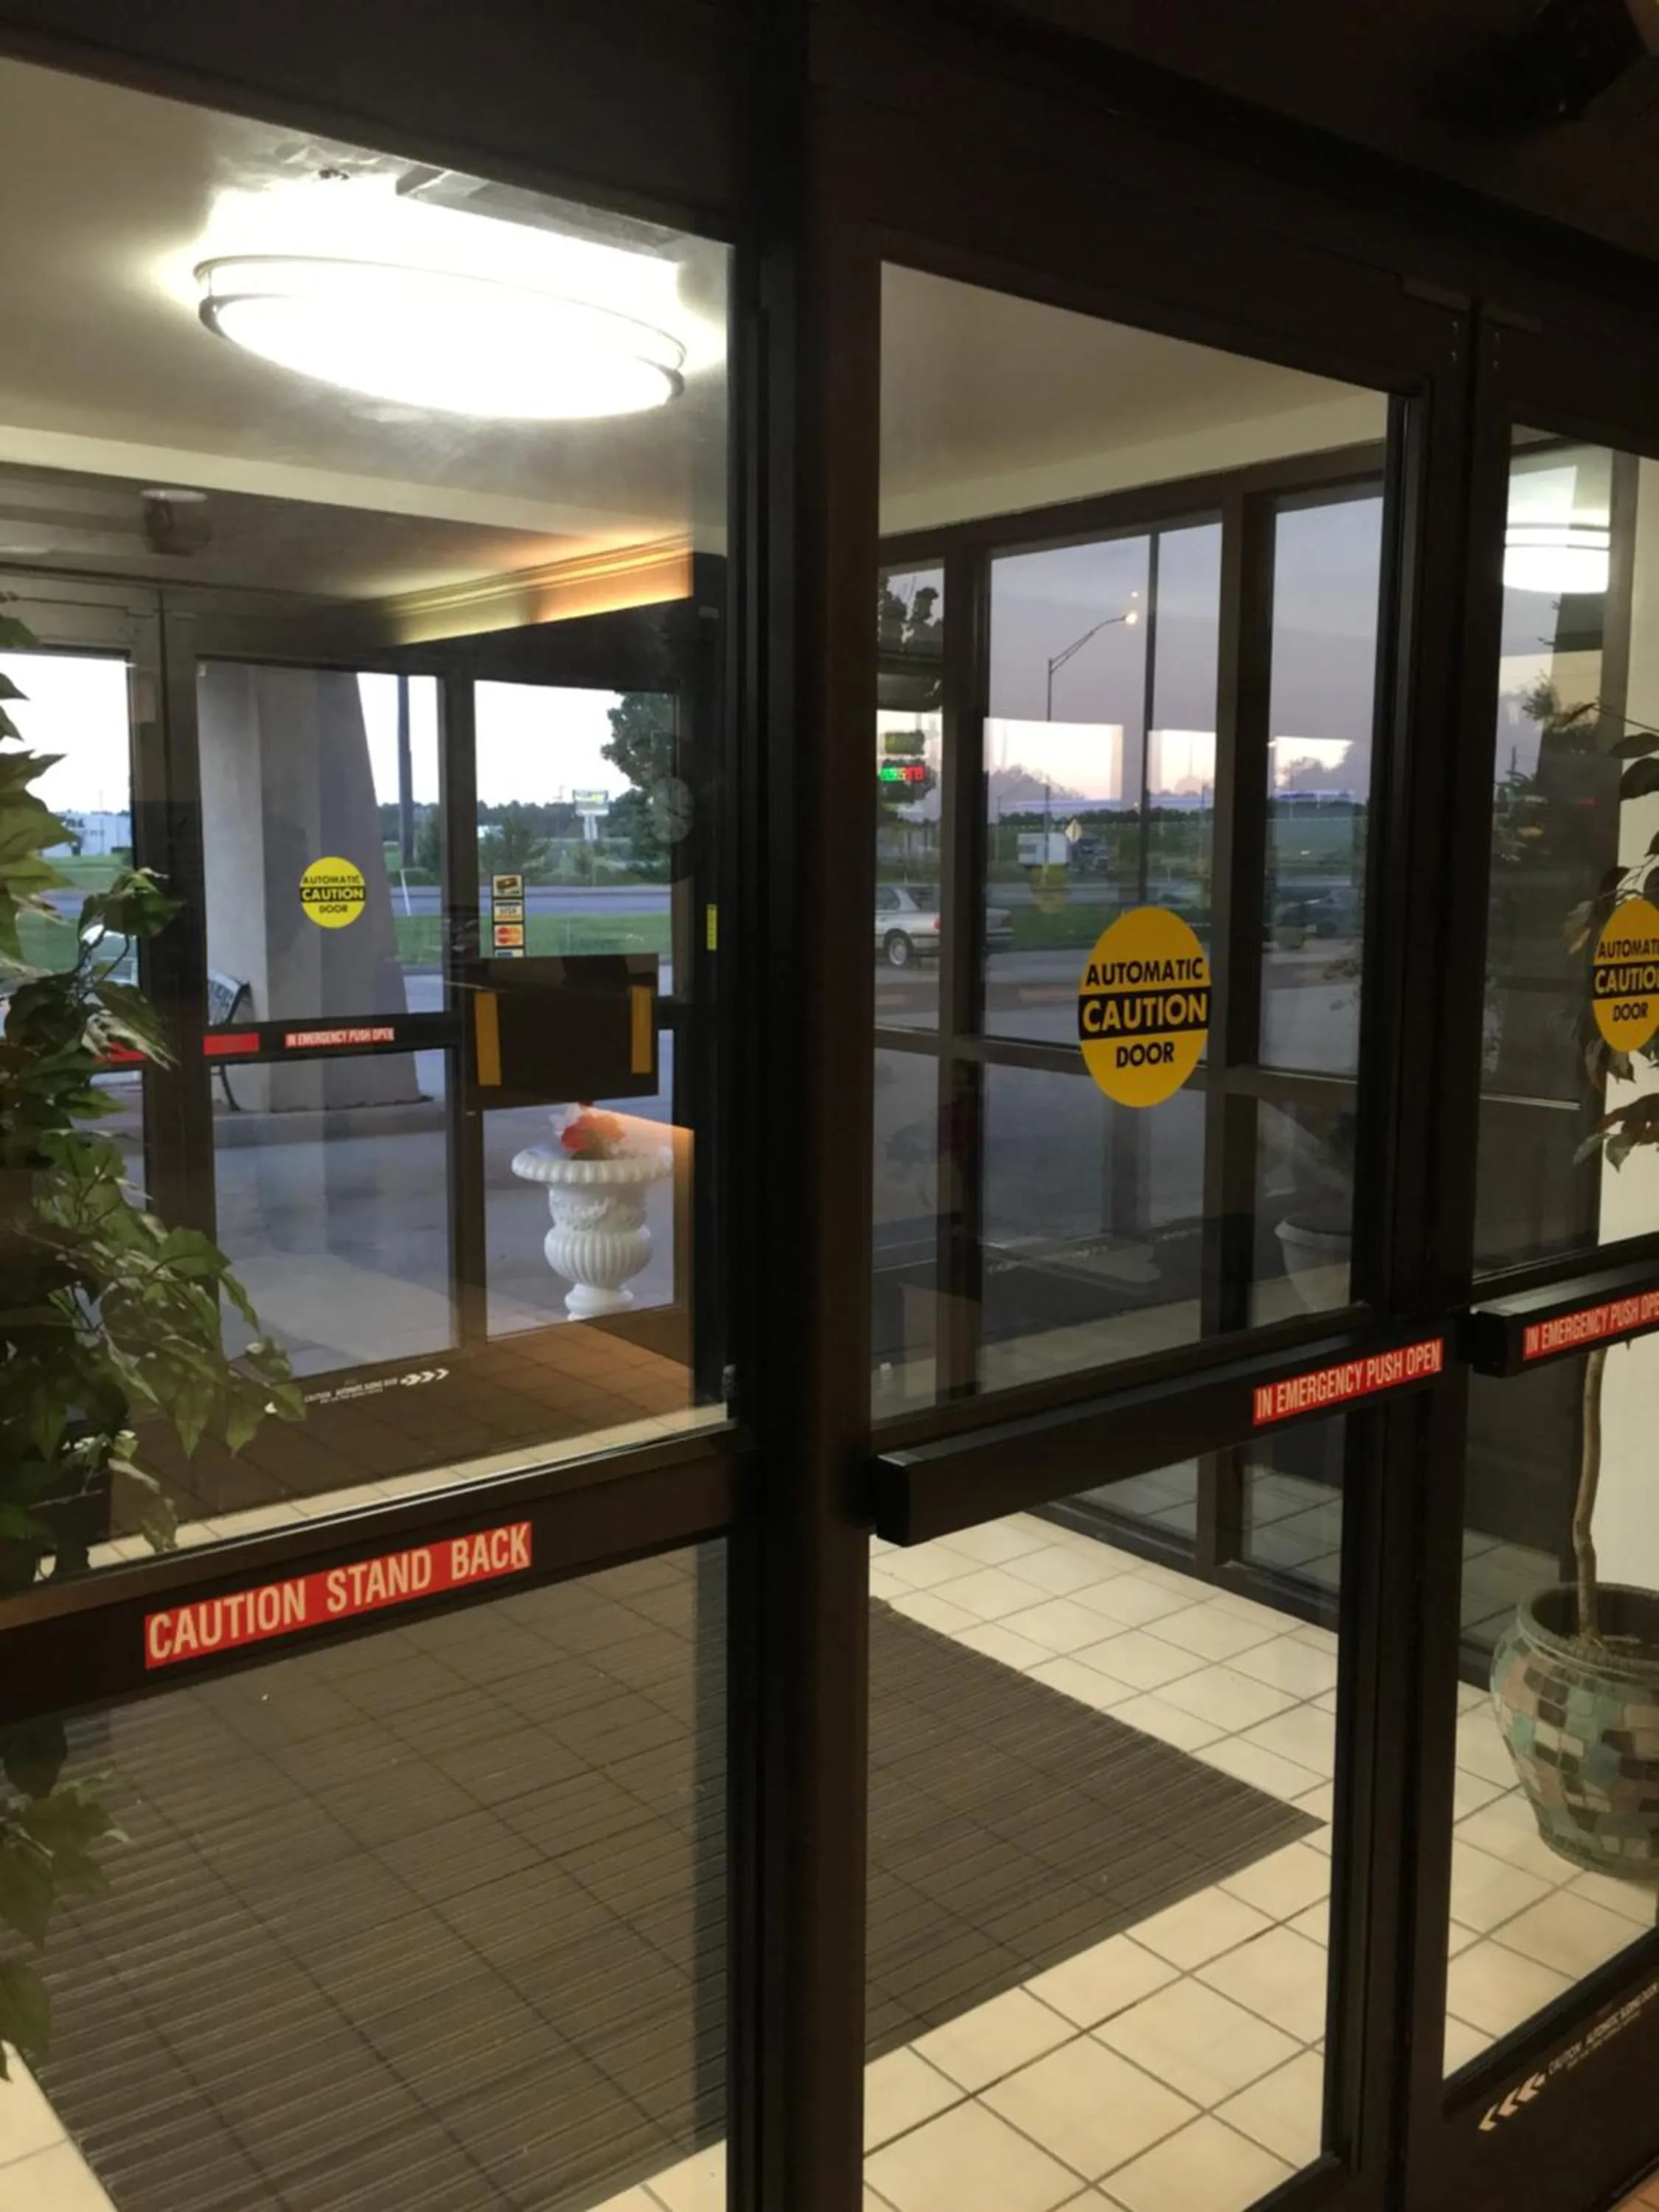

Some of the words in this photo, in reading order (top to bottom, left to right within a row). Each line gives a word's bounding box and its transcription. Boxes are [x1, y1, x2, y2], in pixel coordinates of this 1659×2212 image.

[303, 875, 361, 884] AUTOMATIC
[302, 887, 364, 900] CAUTION
[319, 905, 348, 913] DOOR
[1085, 957, 1204, 987] AUTOMATIC
[1594, 966, 1659, 994] CAUTIO
[1082, 993, 1207, 1033] CAUTION
[1613, 1002, 1649, 1023] DOOR
[349, 1029, 371, 1043] PUSH
[1116, 1042, 1175, 1068] DOOR
[1526, 1324, 1540, 1355] IN
[1541, 1306, 1609, 1350] EMERGENCY
[1610, 1297, 1639, 1329] PUSH
[1256, 1386, 1273, 1420] IN
[1276, 1362, 1364, 1413] EMERGENCY
[1366, 1351, 1402, 1388] PUSH
[1406, 1340, 1442, 1376] OPEN
[148, 1579, 307, 1660] CAUTION
[326, 1549, 432, 1613] STAND
[451, 1523, 532, 1581] BACK
